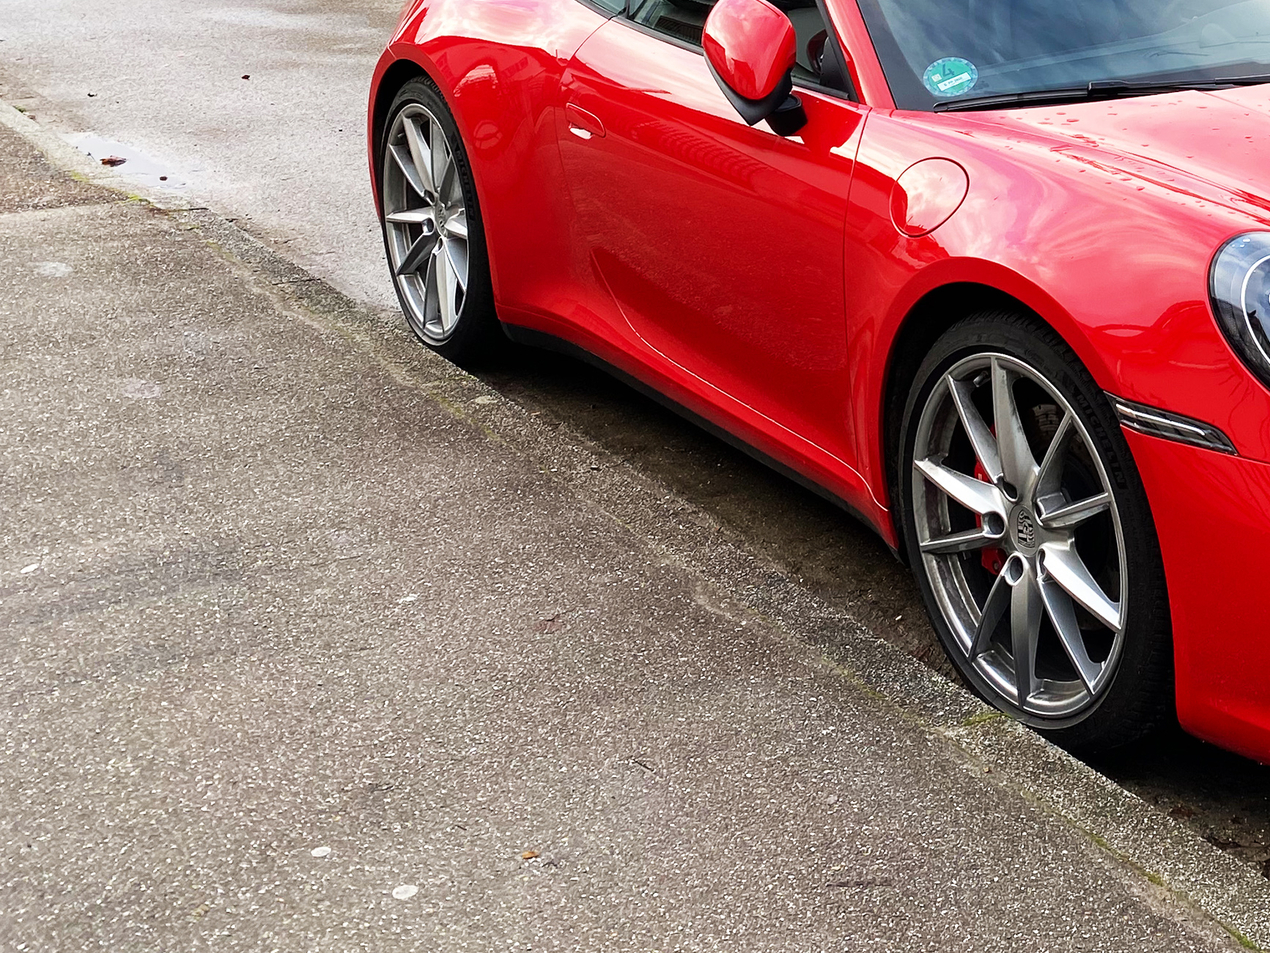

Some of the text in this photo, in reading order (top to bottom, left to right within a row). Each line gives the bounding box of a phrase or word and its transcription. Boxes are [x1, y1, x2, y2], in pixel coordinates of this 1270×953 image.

[942, 63, 955, 77] 4
[456, 150, 474, 217] MICHELIN
[1077, 394, 1125, 483] MICHELIN
